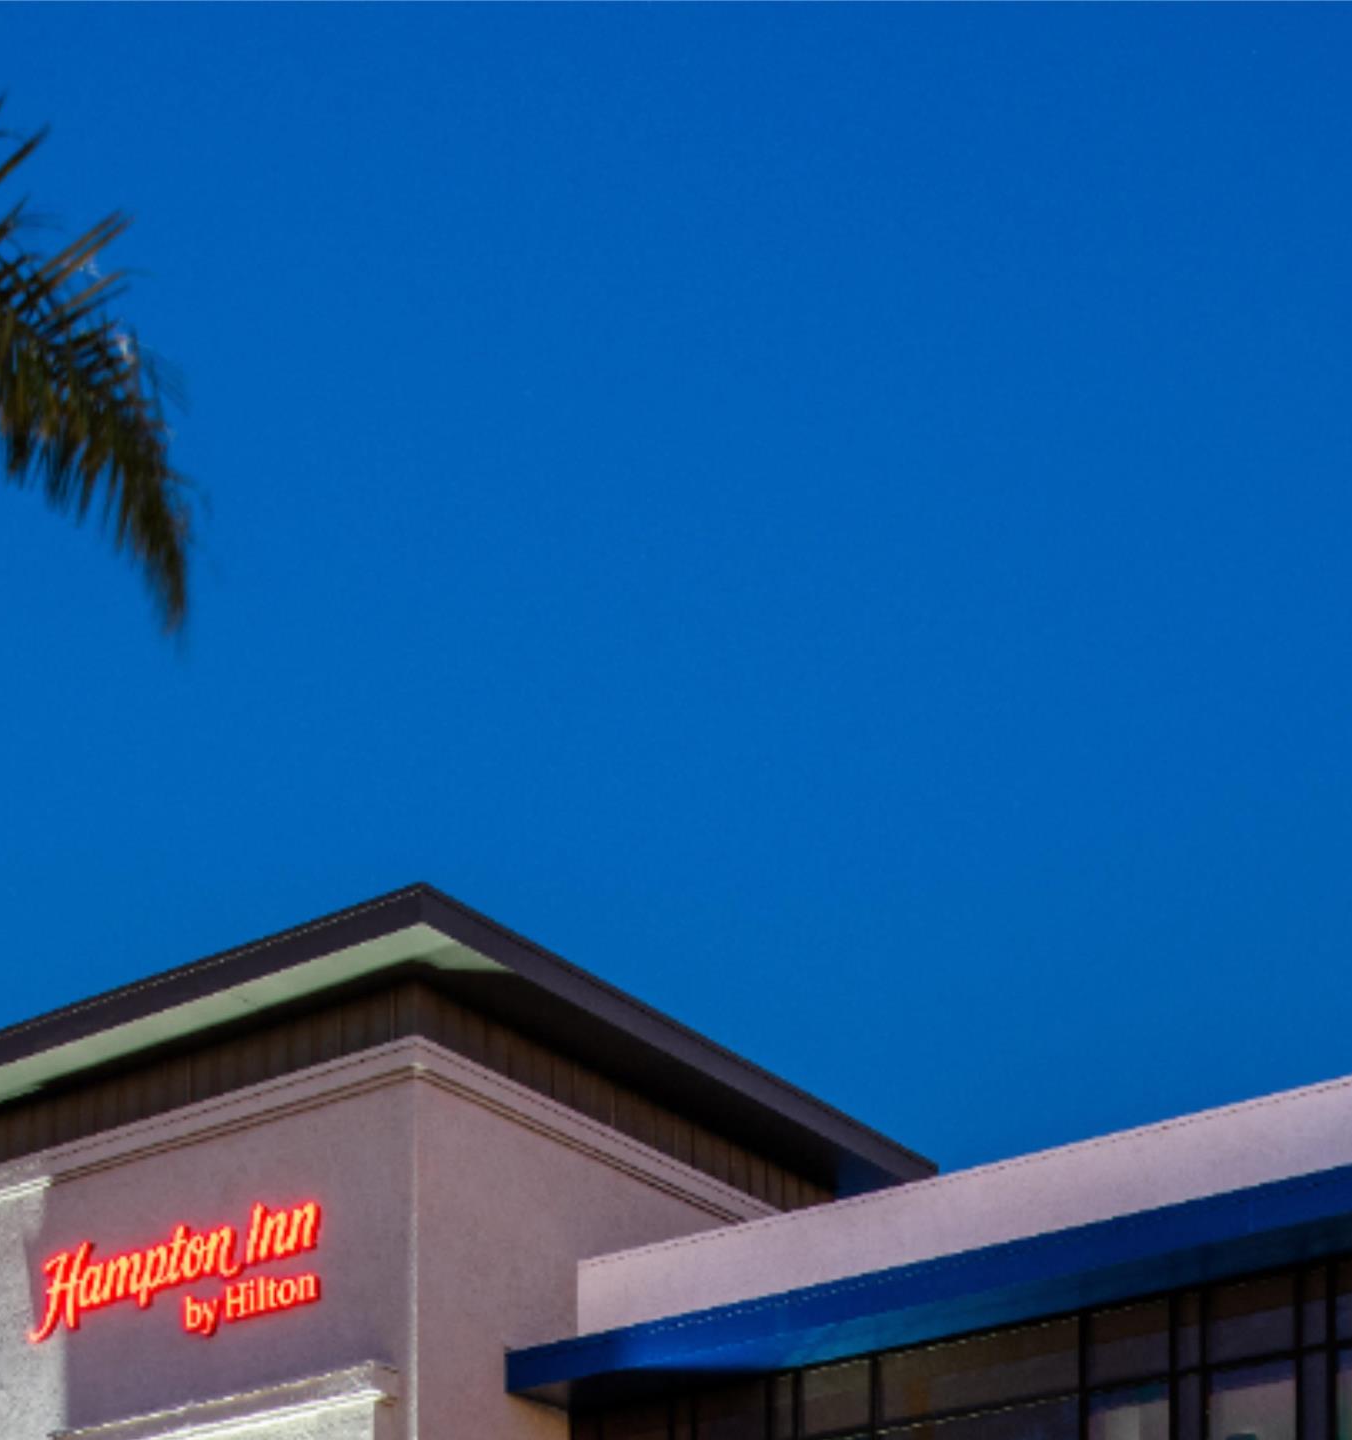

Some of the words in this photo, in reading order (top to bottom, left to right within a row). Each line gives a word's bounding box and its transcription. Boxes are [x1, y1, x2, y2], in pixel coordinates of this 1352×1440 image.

[27, 1224, 240, 1343] Hampton
[245, 1201, 320, 1264] Inn
[184, 1296, 217, 1336] by
[224, 1273, 320, 1322] Hilton
